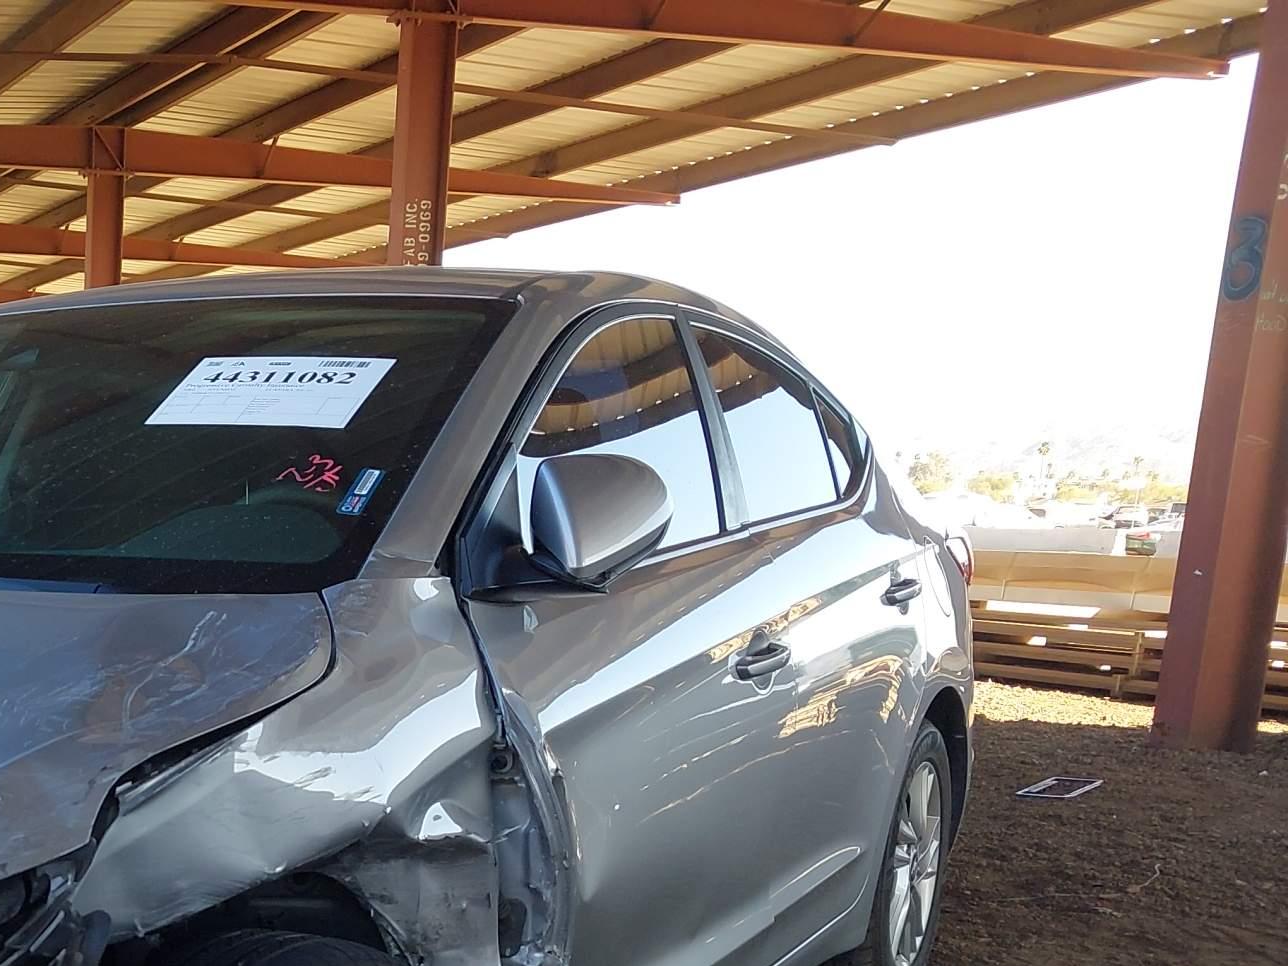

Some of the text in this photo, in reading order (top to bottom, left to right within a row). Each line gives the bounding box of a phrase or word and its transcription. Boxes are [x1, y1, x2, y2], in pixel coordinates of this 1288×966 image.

[405, 198, 418, 228] INC.
[417, 199, 432, 267] 9-0969
[203, 371, 357, 385] 44311082
